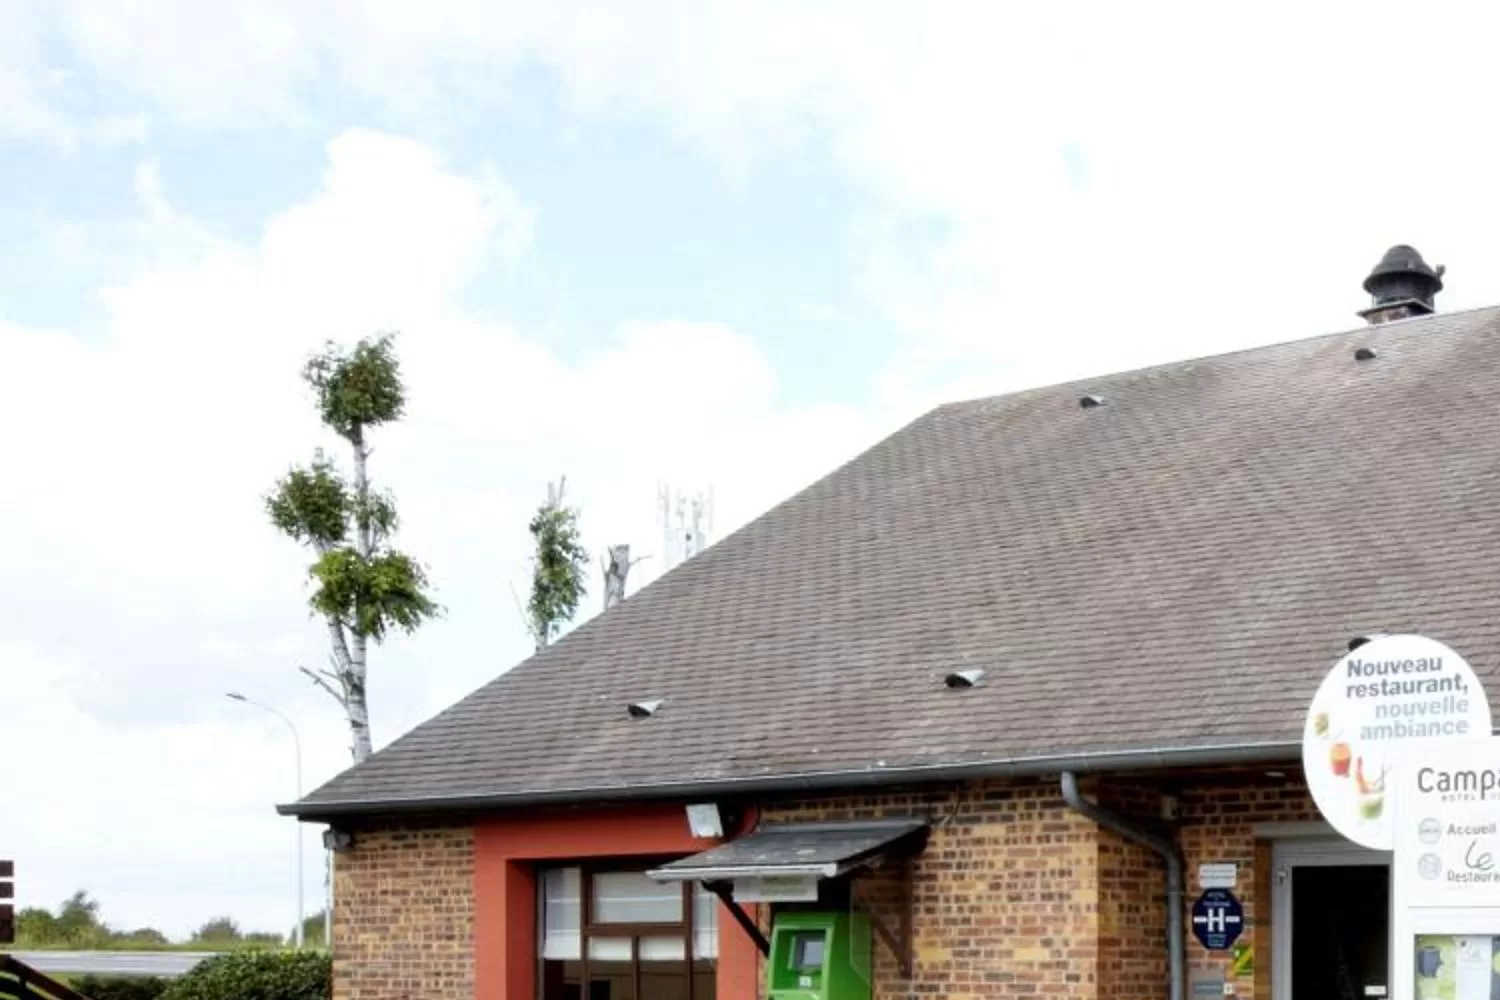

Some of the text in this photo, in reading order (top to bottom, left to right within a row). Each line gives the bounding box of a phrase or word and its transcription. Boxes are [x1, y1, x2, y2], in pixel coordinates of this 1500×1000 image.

[1347, 656, 1443, 678] Nouveau
[1346, 673, 1468, 699] restaurant,
[1375, 696, 1468, 718] nouvelle
[1360, 718, 1468, 740] ambiance
[1447, 822, 1497, 836] Accueil
[1207, 907, 1225, 932] H
